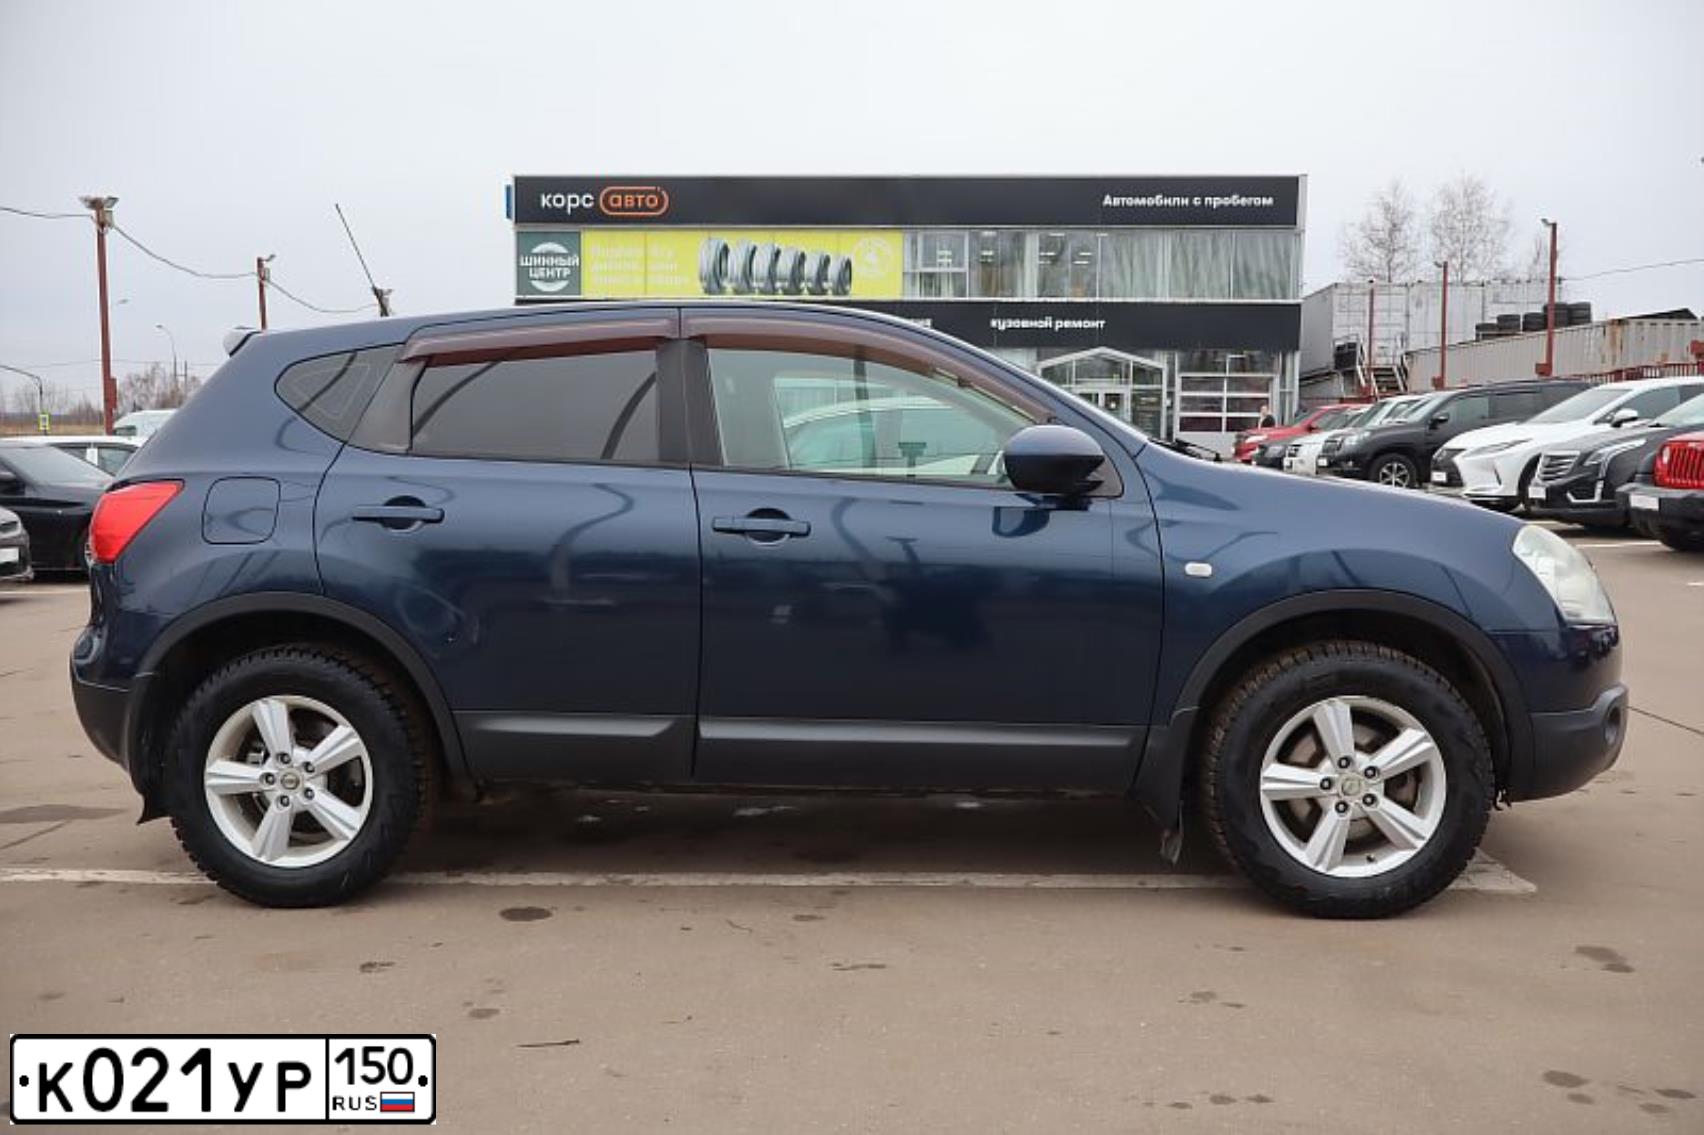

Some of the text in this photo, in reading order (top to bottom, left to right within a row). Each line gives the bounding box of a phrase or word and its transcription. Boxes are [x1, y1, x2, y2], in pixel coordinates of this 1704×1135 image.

[540, 192, 659, 215] корс авто
[1103, 193, 1274, 211] Автомобили с пробегом
[520, 254, 580, 266] ШИННЫЙ
[529, 267, 571, 279] ЦЕНТР
[1055, 318, 1106, 331] ремонт
